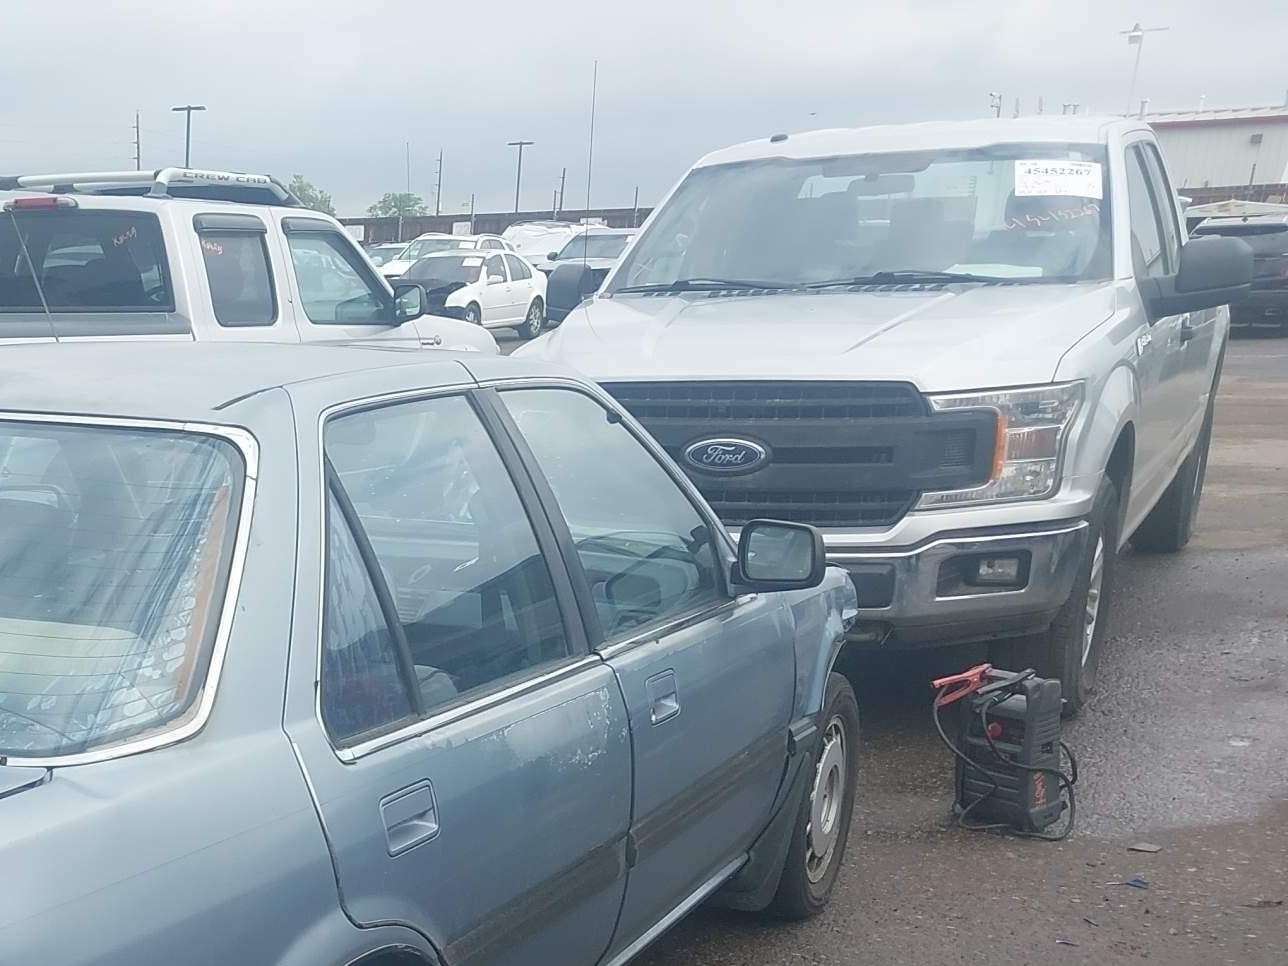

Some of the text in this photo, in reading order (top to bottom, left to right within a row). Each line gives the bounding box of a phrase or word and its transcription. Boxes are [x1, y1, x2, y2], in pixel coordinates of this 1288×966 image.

[183, 171, 231, 182] CREW
[1023, 167, 1092, 177] 45452267
[703, 445, 747, 465] Ford
